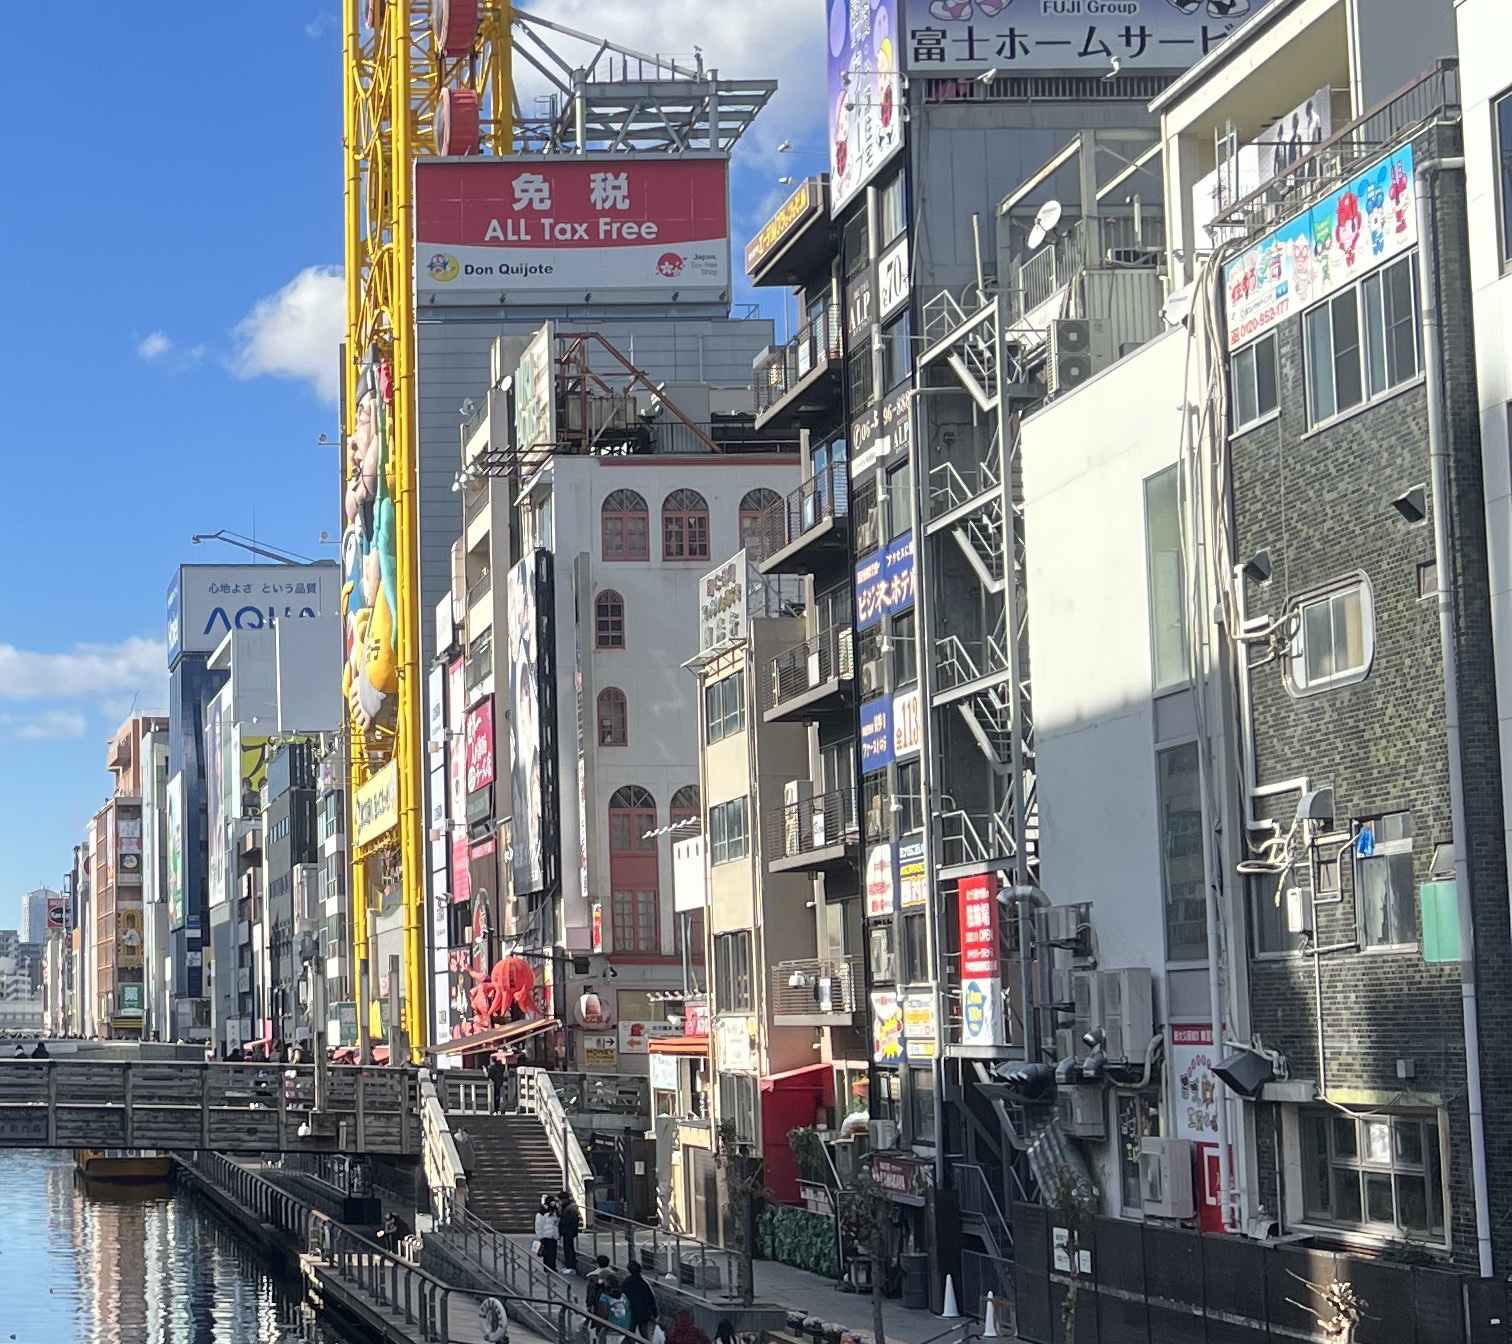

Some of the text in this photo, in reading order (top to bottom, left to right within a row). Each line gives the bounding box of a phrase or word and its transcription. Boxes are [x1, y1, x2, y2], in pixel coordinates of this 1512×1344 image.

[1042, 0, 1140, 17] FUJI Group
[511, 172, 630, 211] 免税
[484, 217, 658, 242] ALL Tax Free
[464, 261, 554, 278] Don Quijote
[208, 583, 317, 594] 心地よさ という品質
